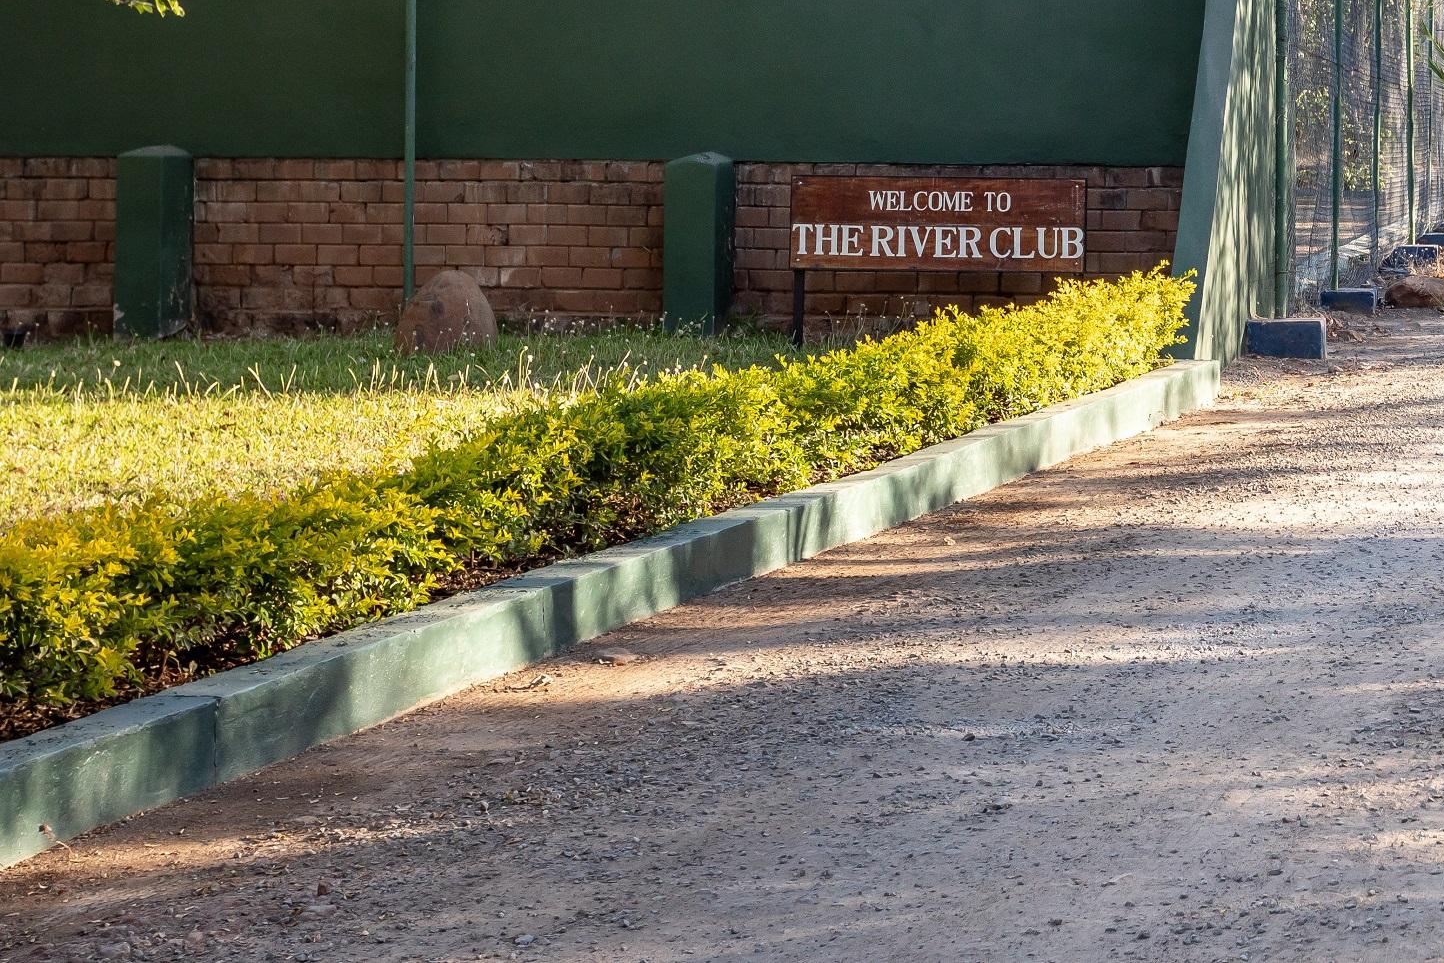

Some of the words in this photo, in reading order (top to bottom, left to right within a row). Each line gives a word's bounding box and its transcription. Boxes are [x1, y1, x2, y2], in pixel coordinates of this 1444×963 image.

[868, 190, 973, 211] WELCOME
[984, 191, 1012, 212] TO
[792, 223, 864, 257] THE
[870, 225, 982, 258] RIVER
[989, 227, 1084, 259] CLUB
